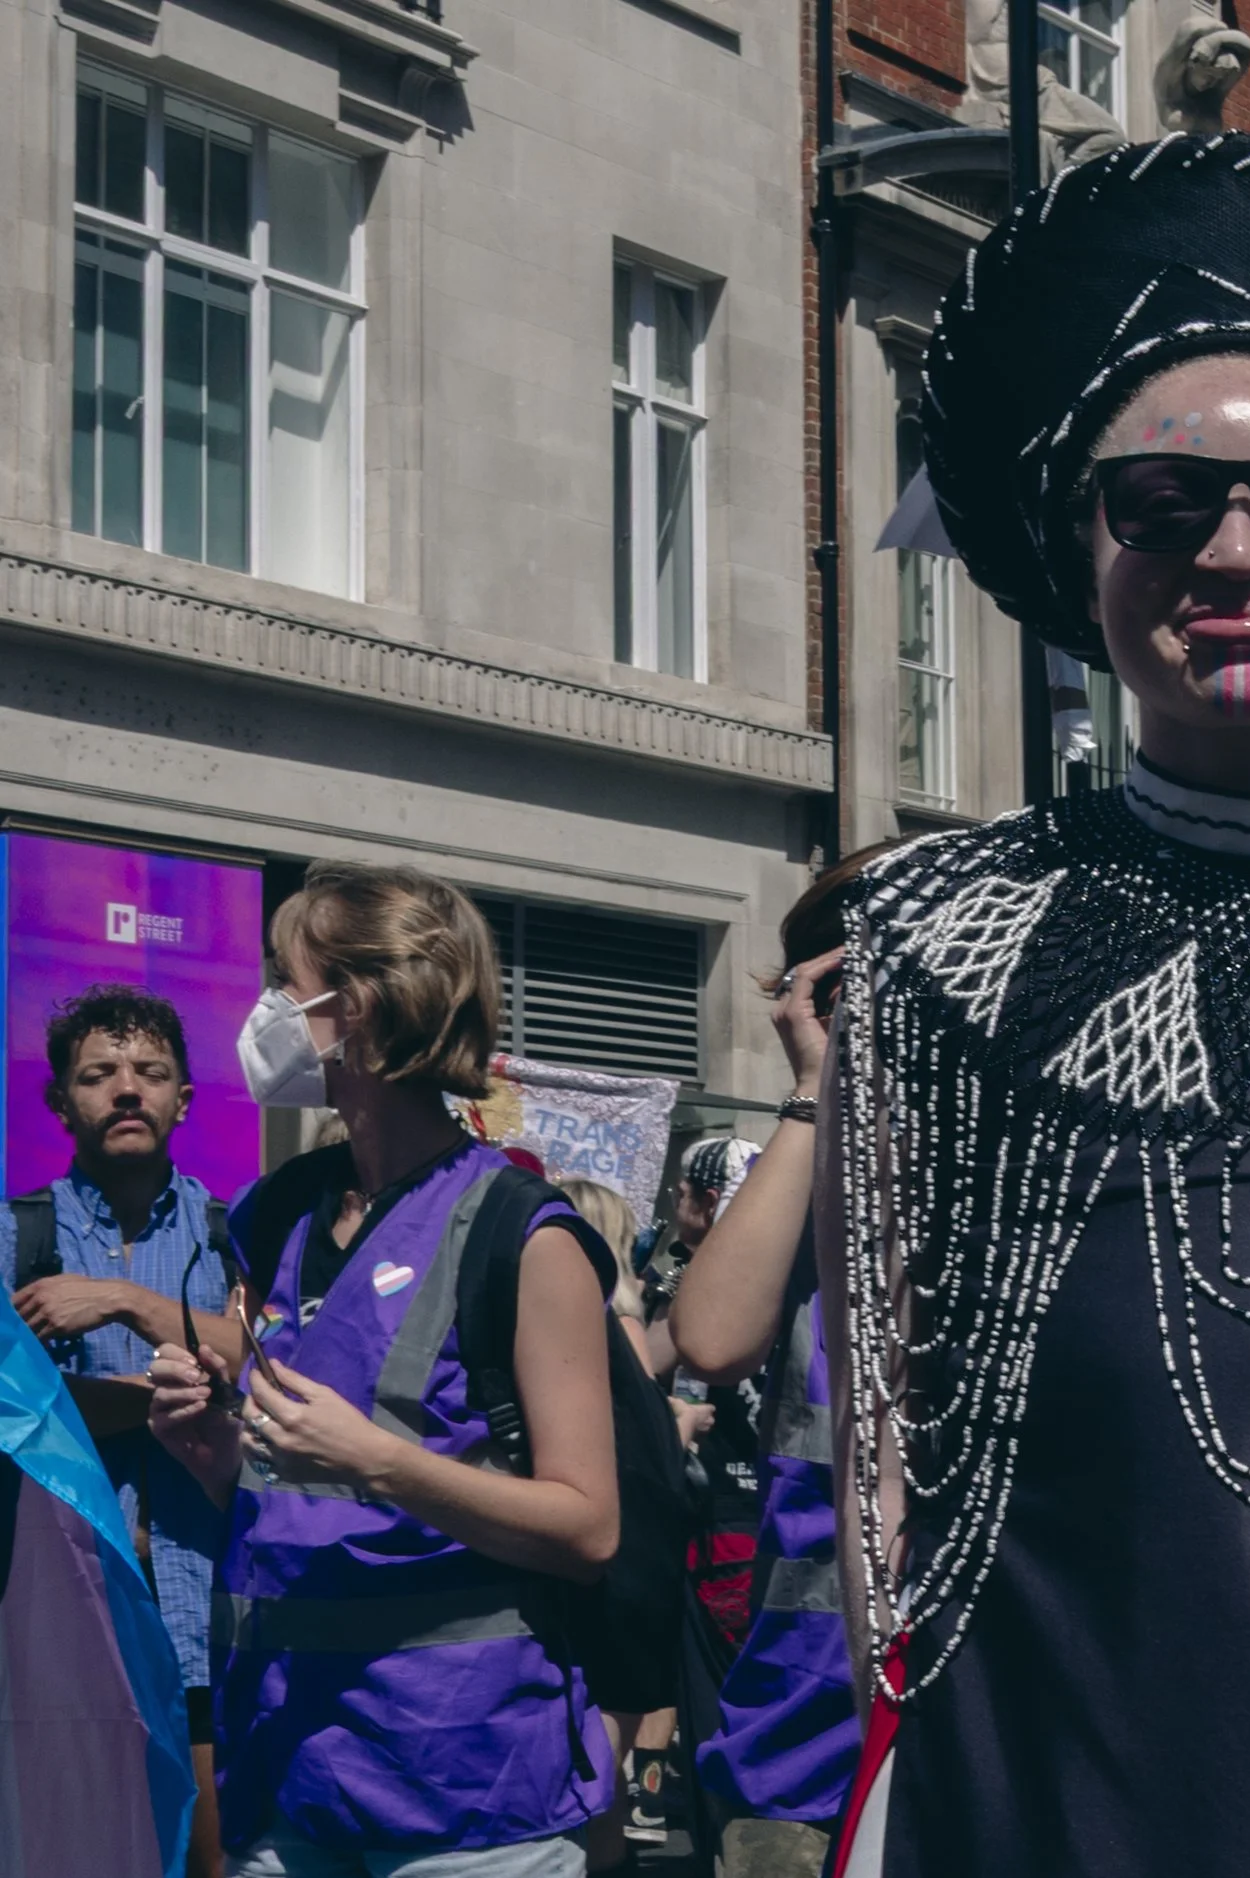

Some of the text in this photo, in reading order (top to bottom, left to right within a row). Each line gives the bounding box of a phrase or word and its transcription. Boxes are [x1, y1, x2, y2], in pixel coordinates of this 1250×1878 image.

[139, 913, 184, 930] REGENT
[139, 926, 184, 943] STREET
[535, 1108, 642, 1152] TRANS
[546, 1139, 634, 1181] RAGE
